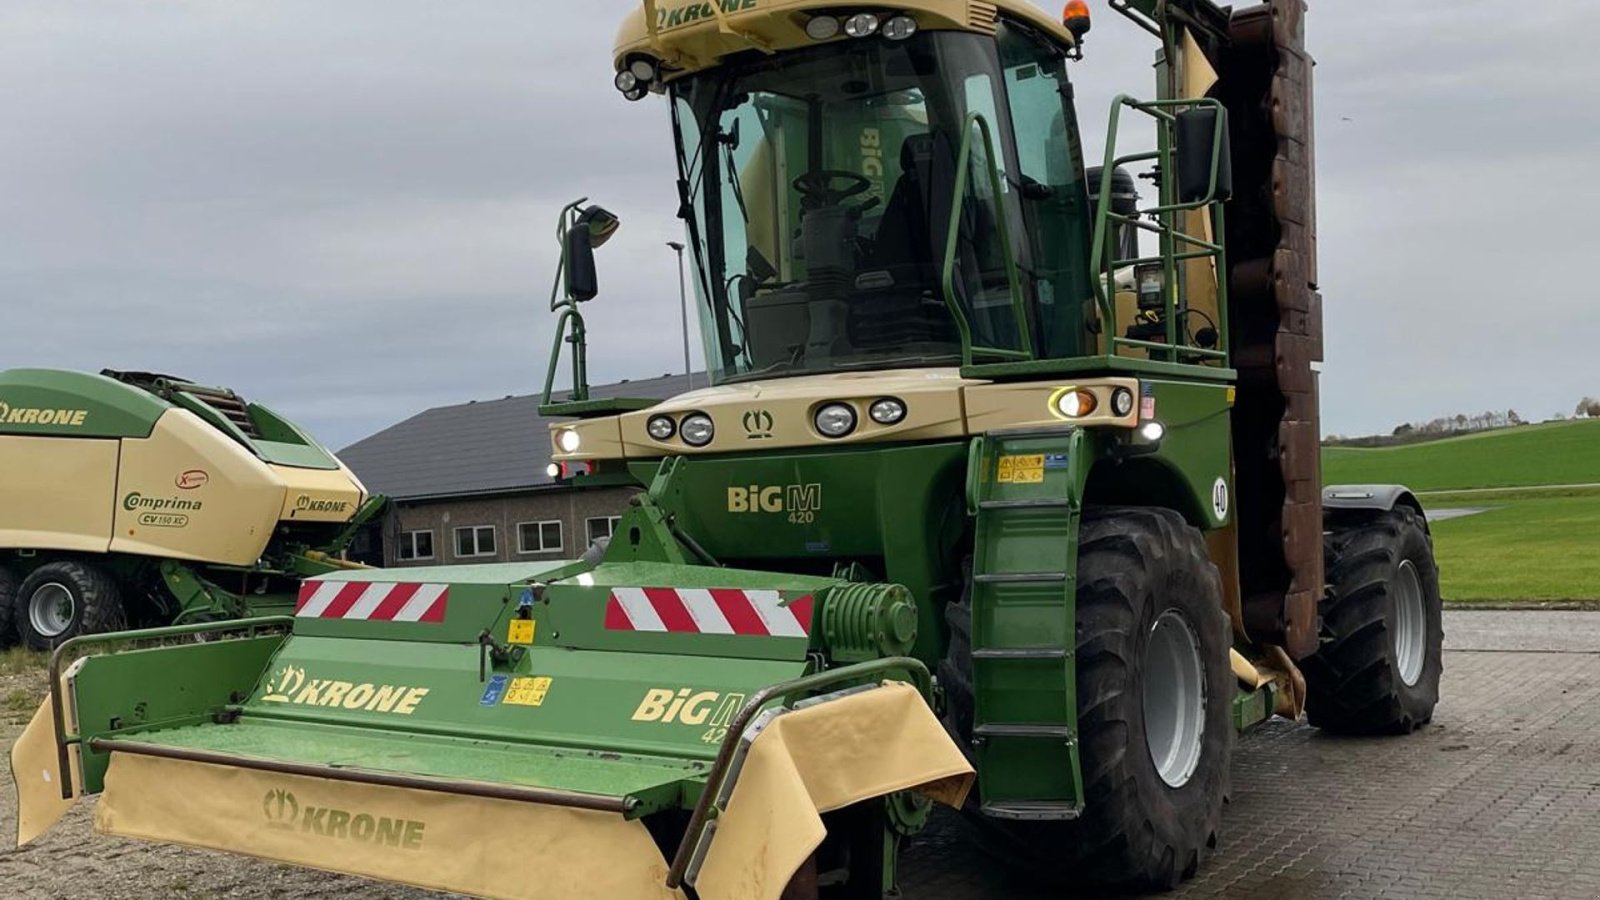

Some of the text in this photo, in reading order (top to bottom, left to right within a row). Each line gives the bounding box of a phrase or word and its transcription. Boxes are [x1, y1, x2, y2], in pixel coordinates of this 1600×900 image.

[7, 408, 88, 426] KRONE
[123, 491, 203, 511] Comprima
[308, 500, 347, 512] KRONE
[727, 483, 822, 513] BiG M
[1214, 484, 1226, 513] 40
[787, 511, 815, 524] 420
[294, 679, 430, 715] KRONE
[631, 688, 720, 726] BiG
[701, 727, 728, 744] 42
[302, 806, 426, 849] KRONE
